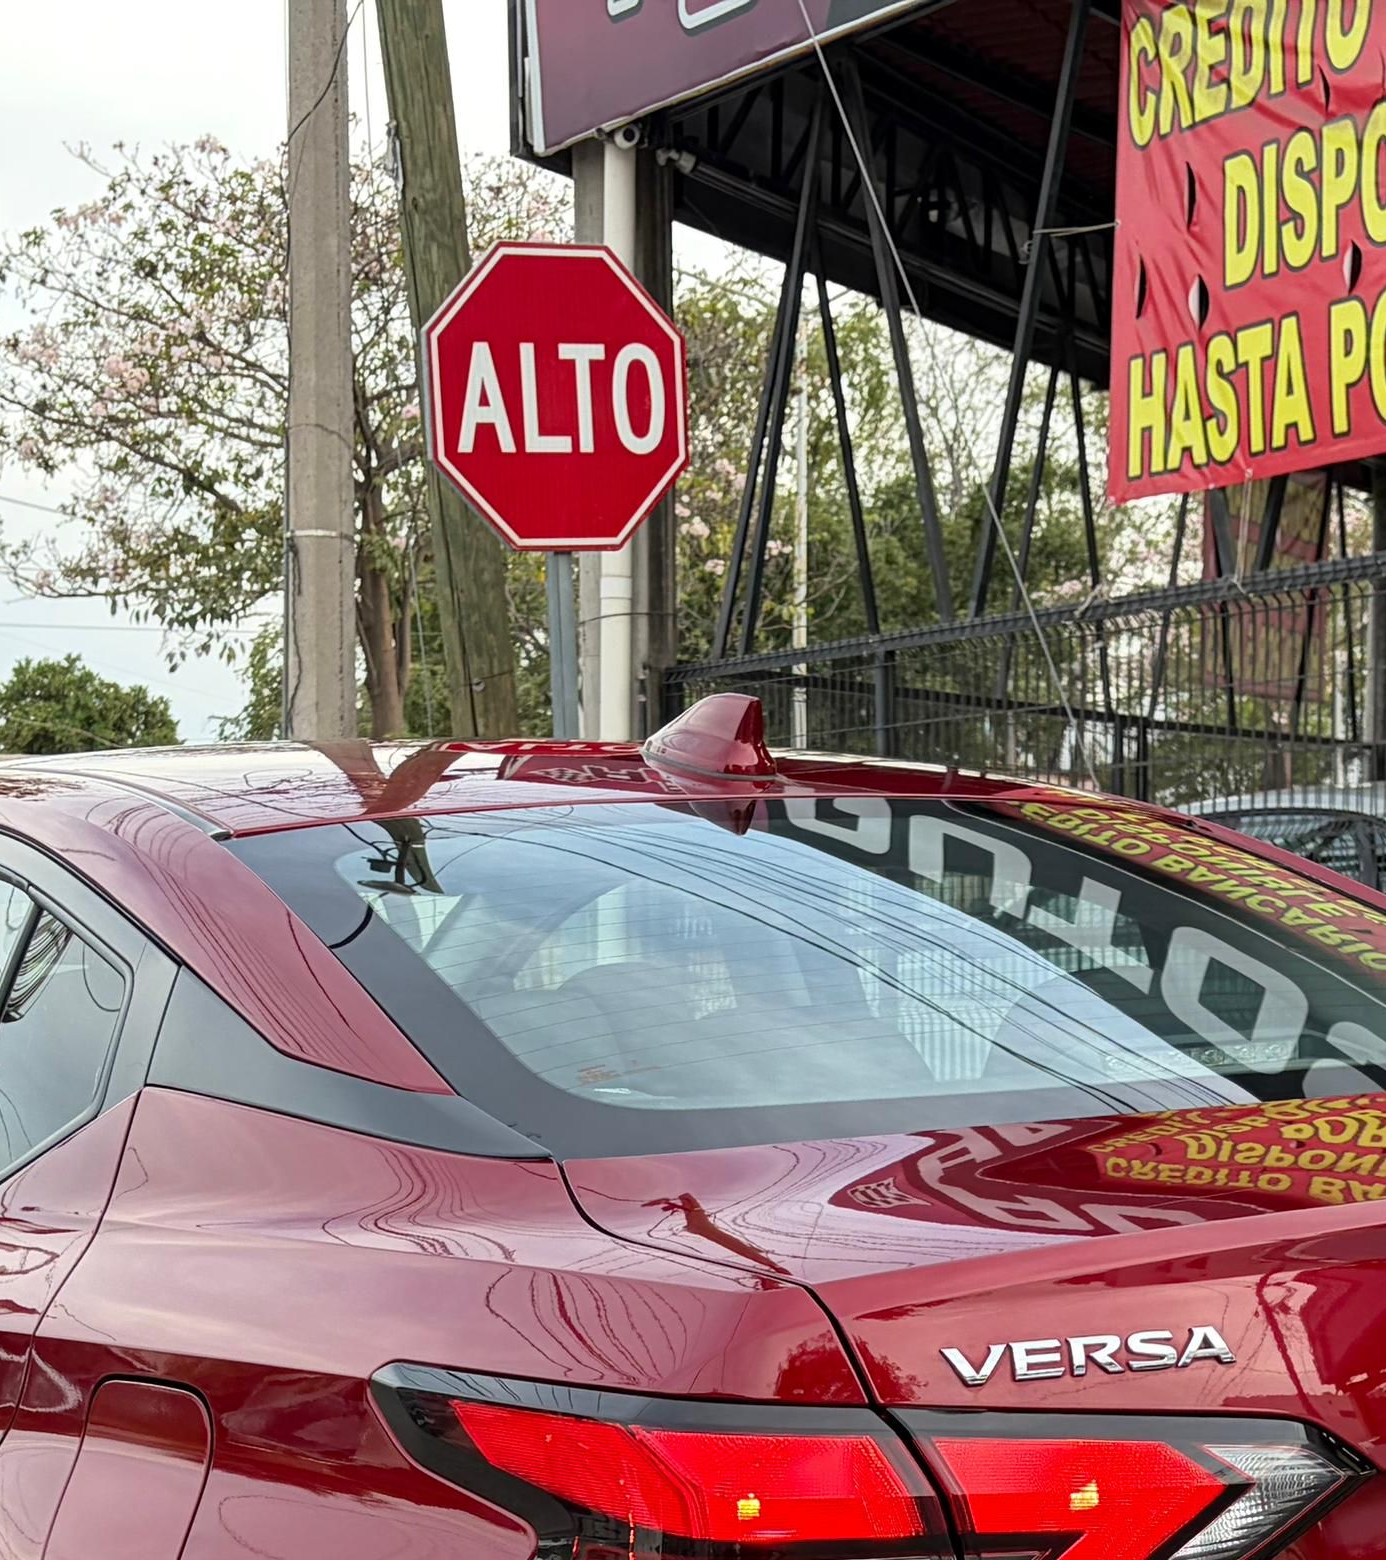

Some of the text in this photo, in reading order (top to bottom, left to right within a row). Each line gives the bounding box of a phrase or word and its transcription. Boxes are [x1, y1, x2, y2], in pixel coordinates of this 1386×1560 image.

[457, 341, 666, 455] ALTO
[1125, 309, 1316, 481] HASTA
[939, 1323, 1237, 1388] VERSA
